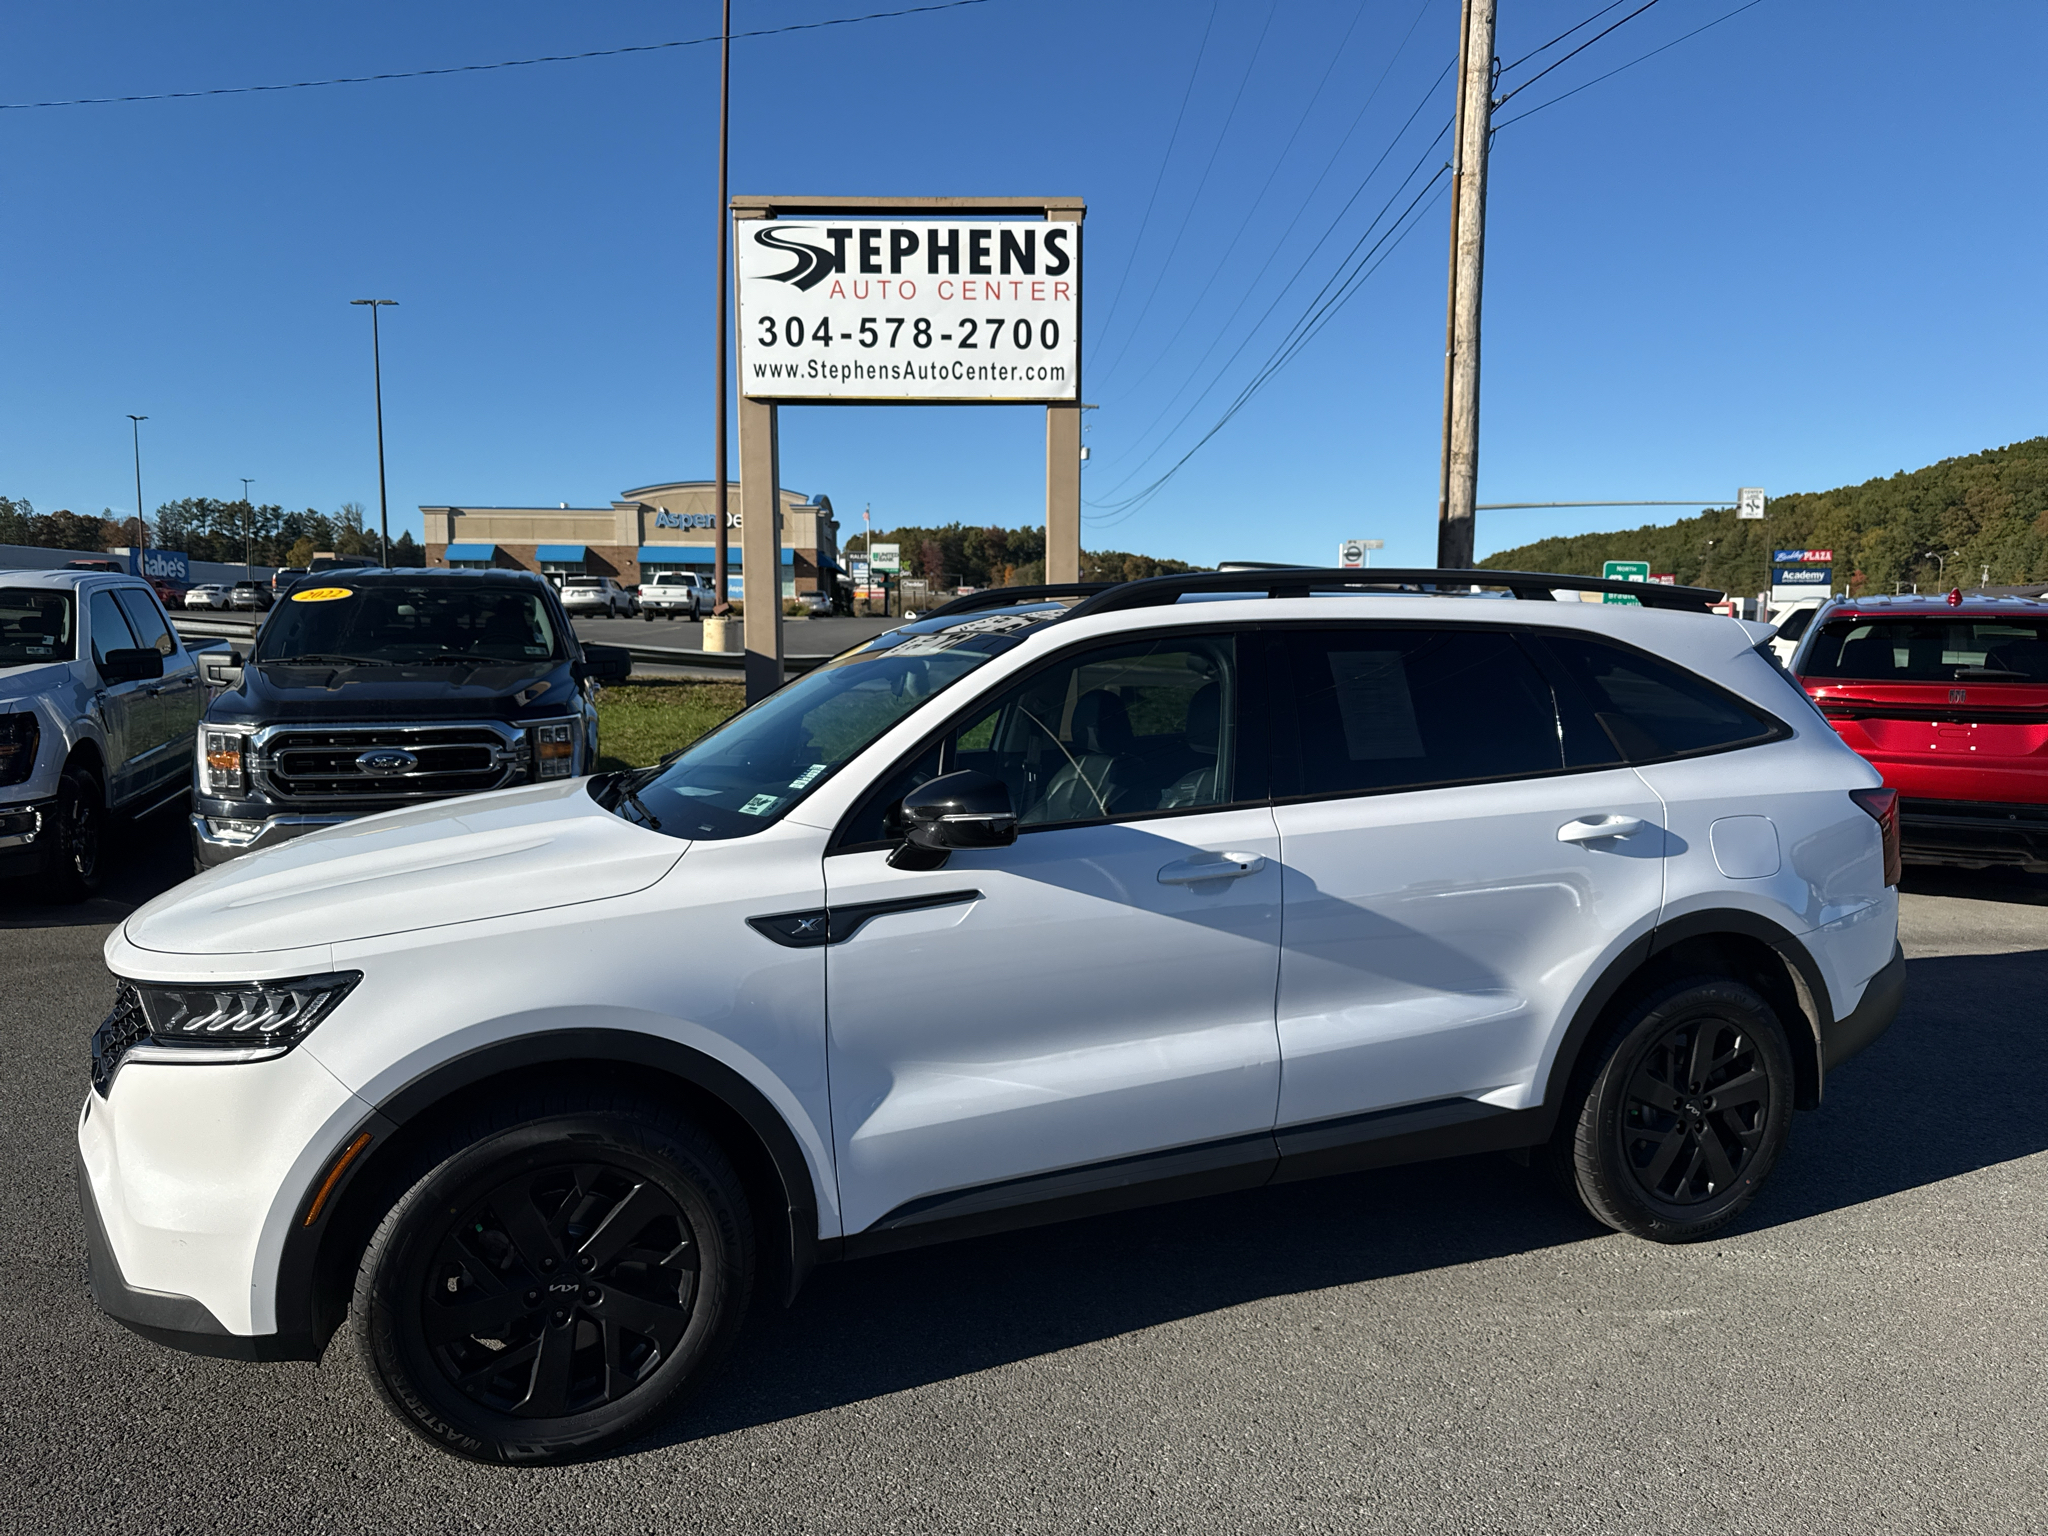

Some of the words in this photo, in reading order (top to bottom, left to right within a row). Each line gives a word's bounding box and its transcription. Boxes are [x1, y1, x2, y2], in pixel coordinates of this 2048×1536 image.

[747, 226, 1071, 292] STEPHENS
[829, 280, 917, 300] AUTO
[938, 281, 1071, 301] CENTER
[757, 316, 1060, 350] 304-578-2700
[753, 359, 1066, 385] www.StephensAutoCenter.com
[136, 553, 186, 578] Gabe's
[1803, 551, 1831, 561] PLAZA
[1781, 570, 1825, 582] Academy
[300, 589, 344, 600] 2022
